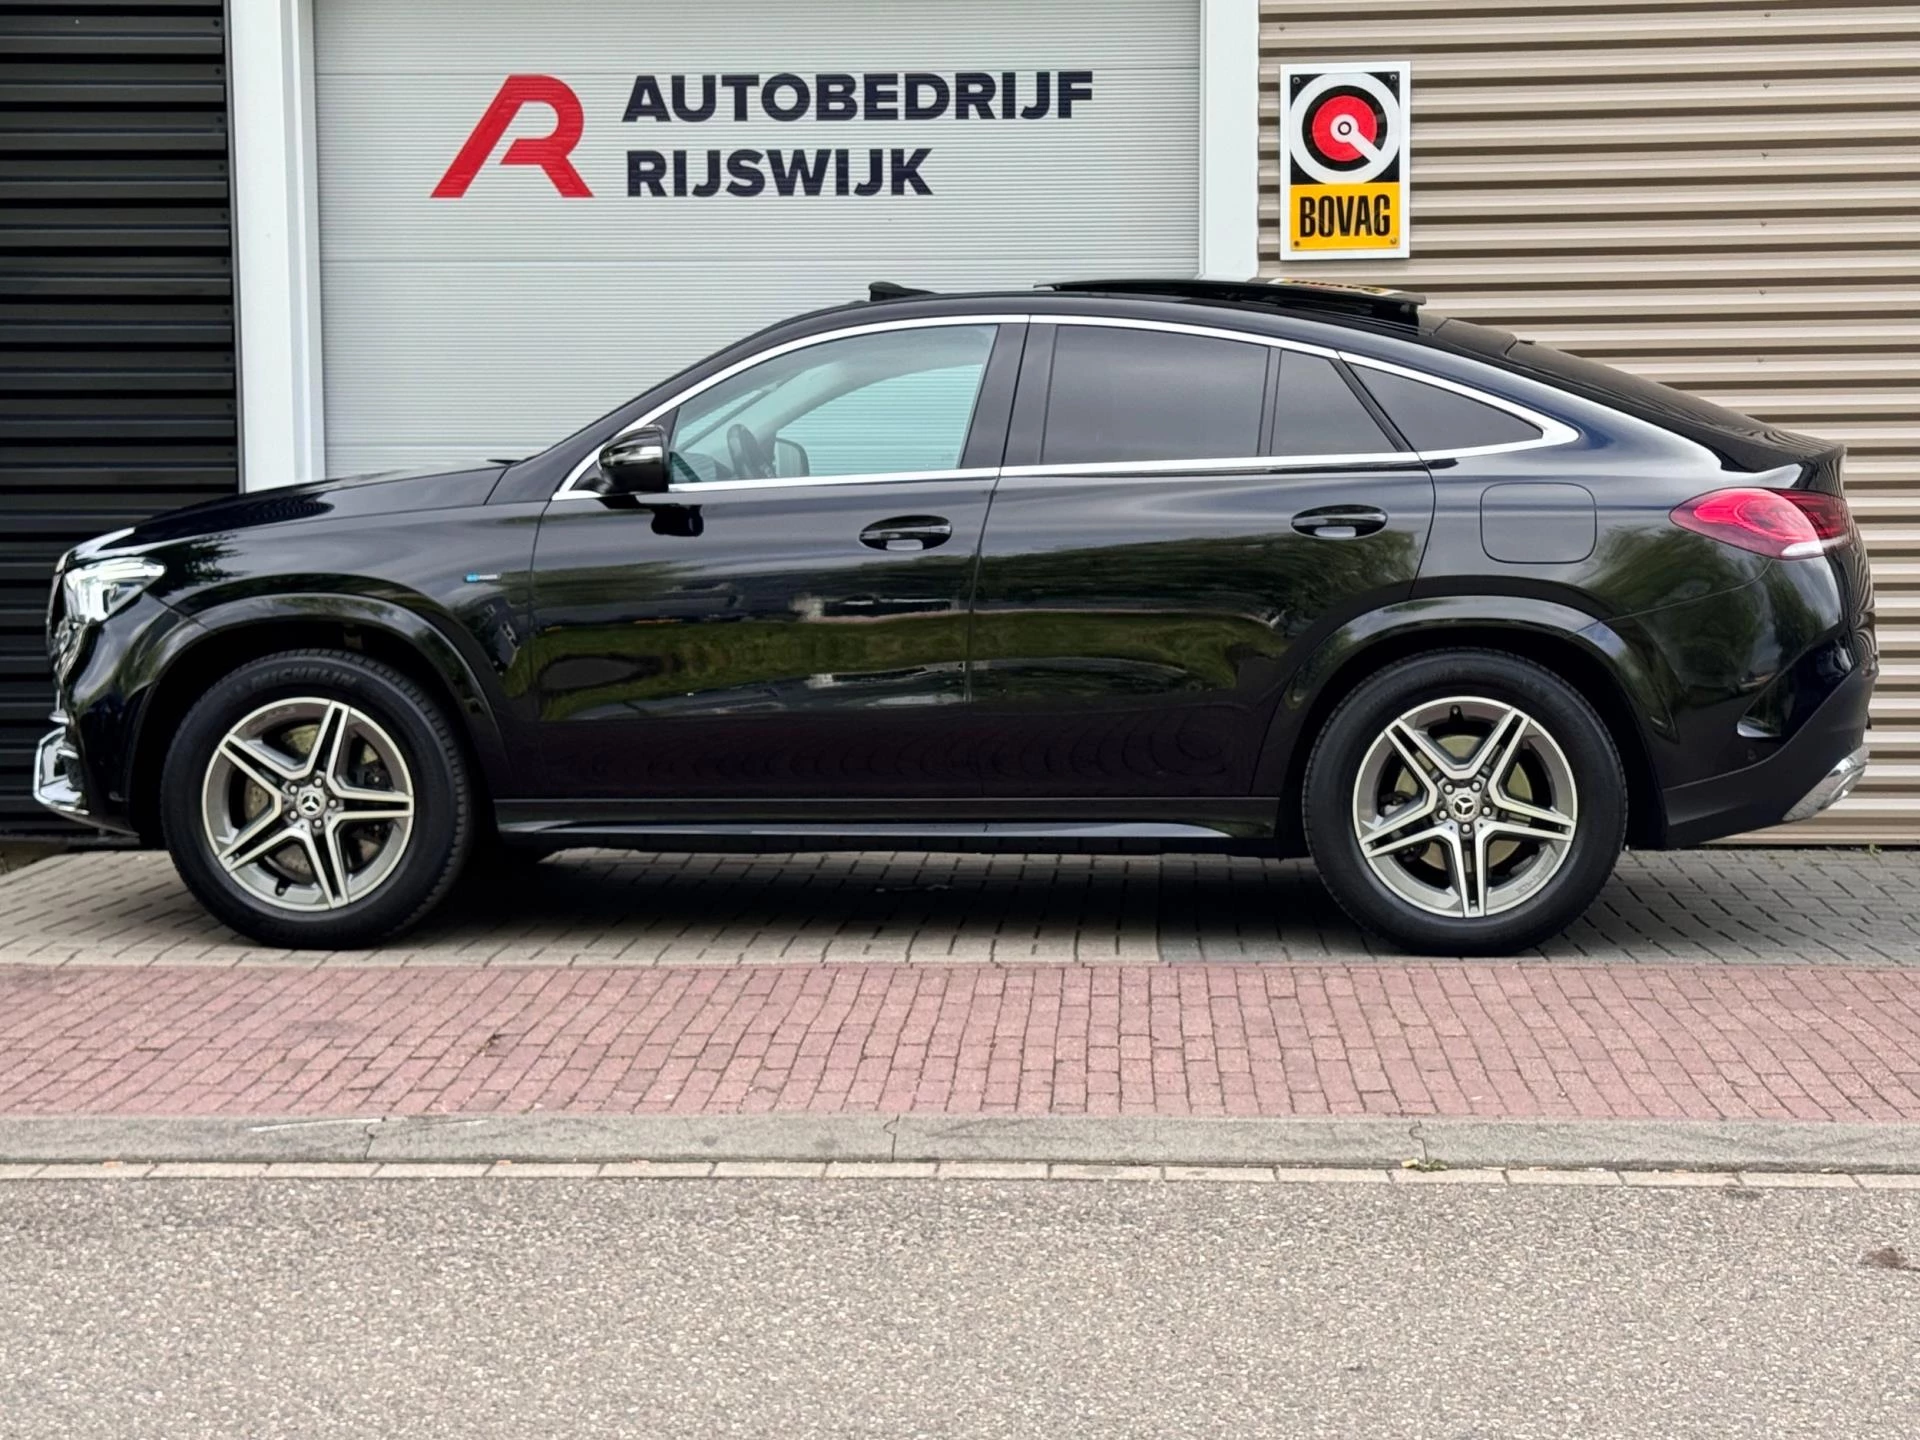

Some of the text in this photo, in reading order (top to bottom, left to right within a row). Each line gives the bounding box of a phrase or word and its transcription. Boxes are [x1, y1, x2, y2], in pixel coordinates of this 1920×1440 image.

[622, 71, 1093, 122] AUTOBEDRIJF
[627, 148, 933, 197] RIJSWIJK
[1299, 194, 1391, 237] BOVAG
[251, 667, 357, 689] MICHELIN
